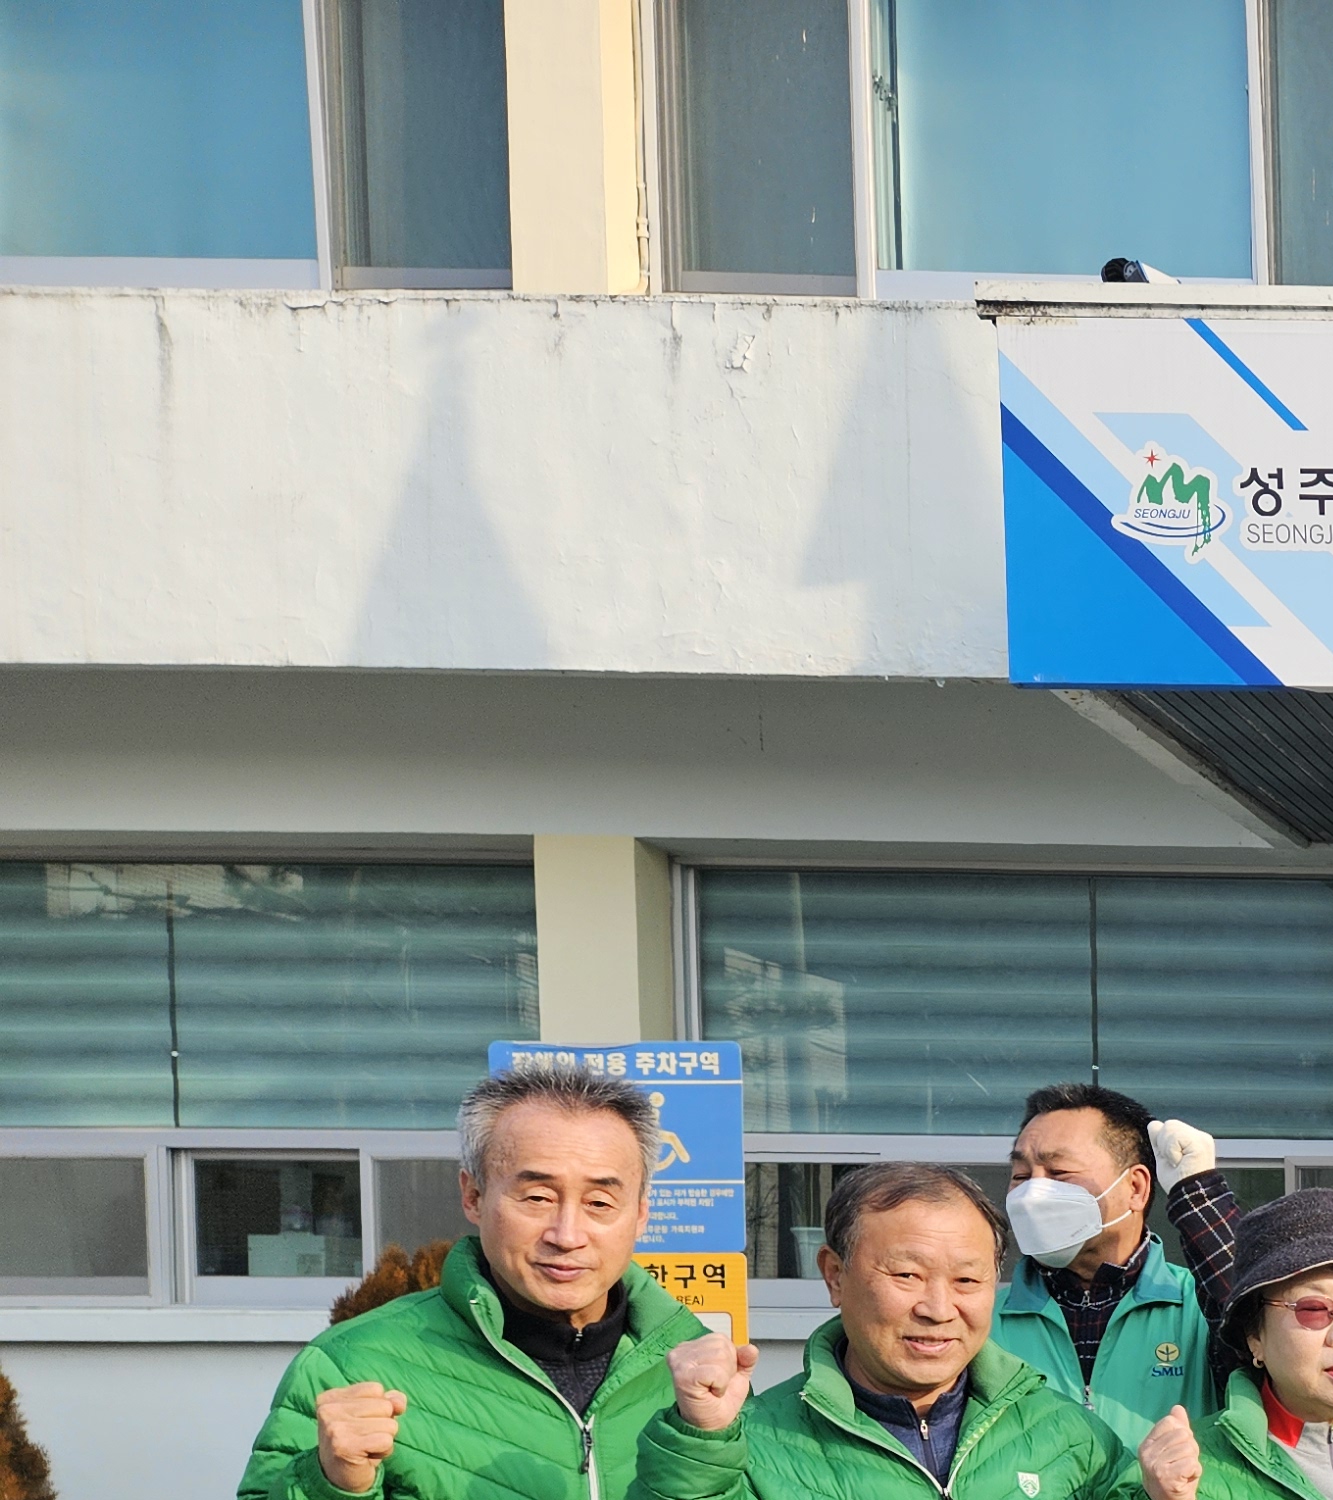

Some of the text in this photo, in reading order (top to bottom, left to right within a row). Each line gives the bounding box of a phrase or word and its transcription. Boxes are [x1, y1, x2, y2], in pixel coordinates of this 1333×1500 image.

[1134, 508, 1191, 520] SEONGJU
[584, 1052, 626, 1076] 전용
[636, 1052, 720, 1076] 주차구역
[644, 1264, 725, 1289] 한구역
[676, 1294, 704, 1307] REA)
[1151, 1366, 1184, 1378] SMU
